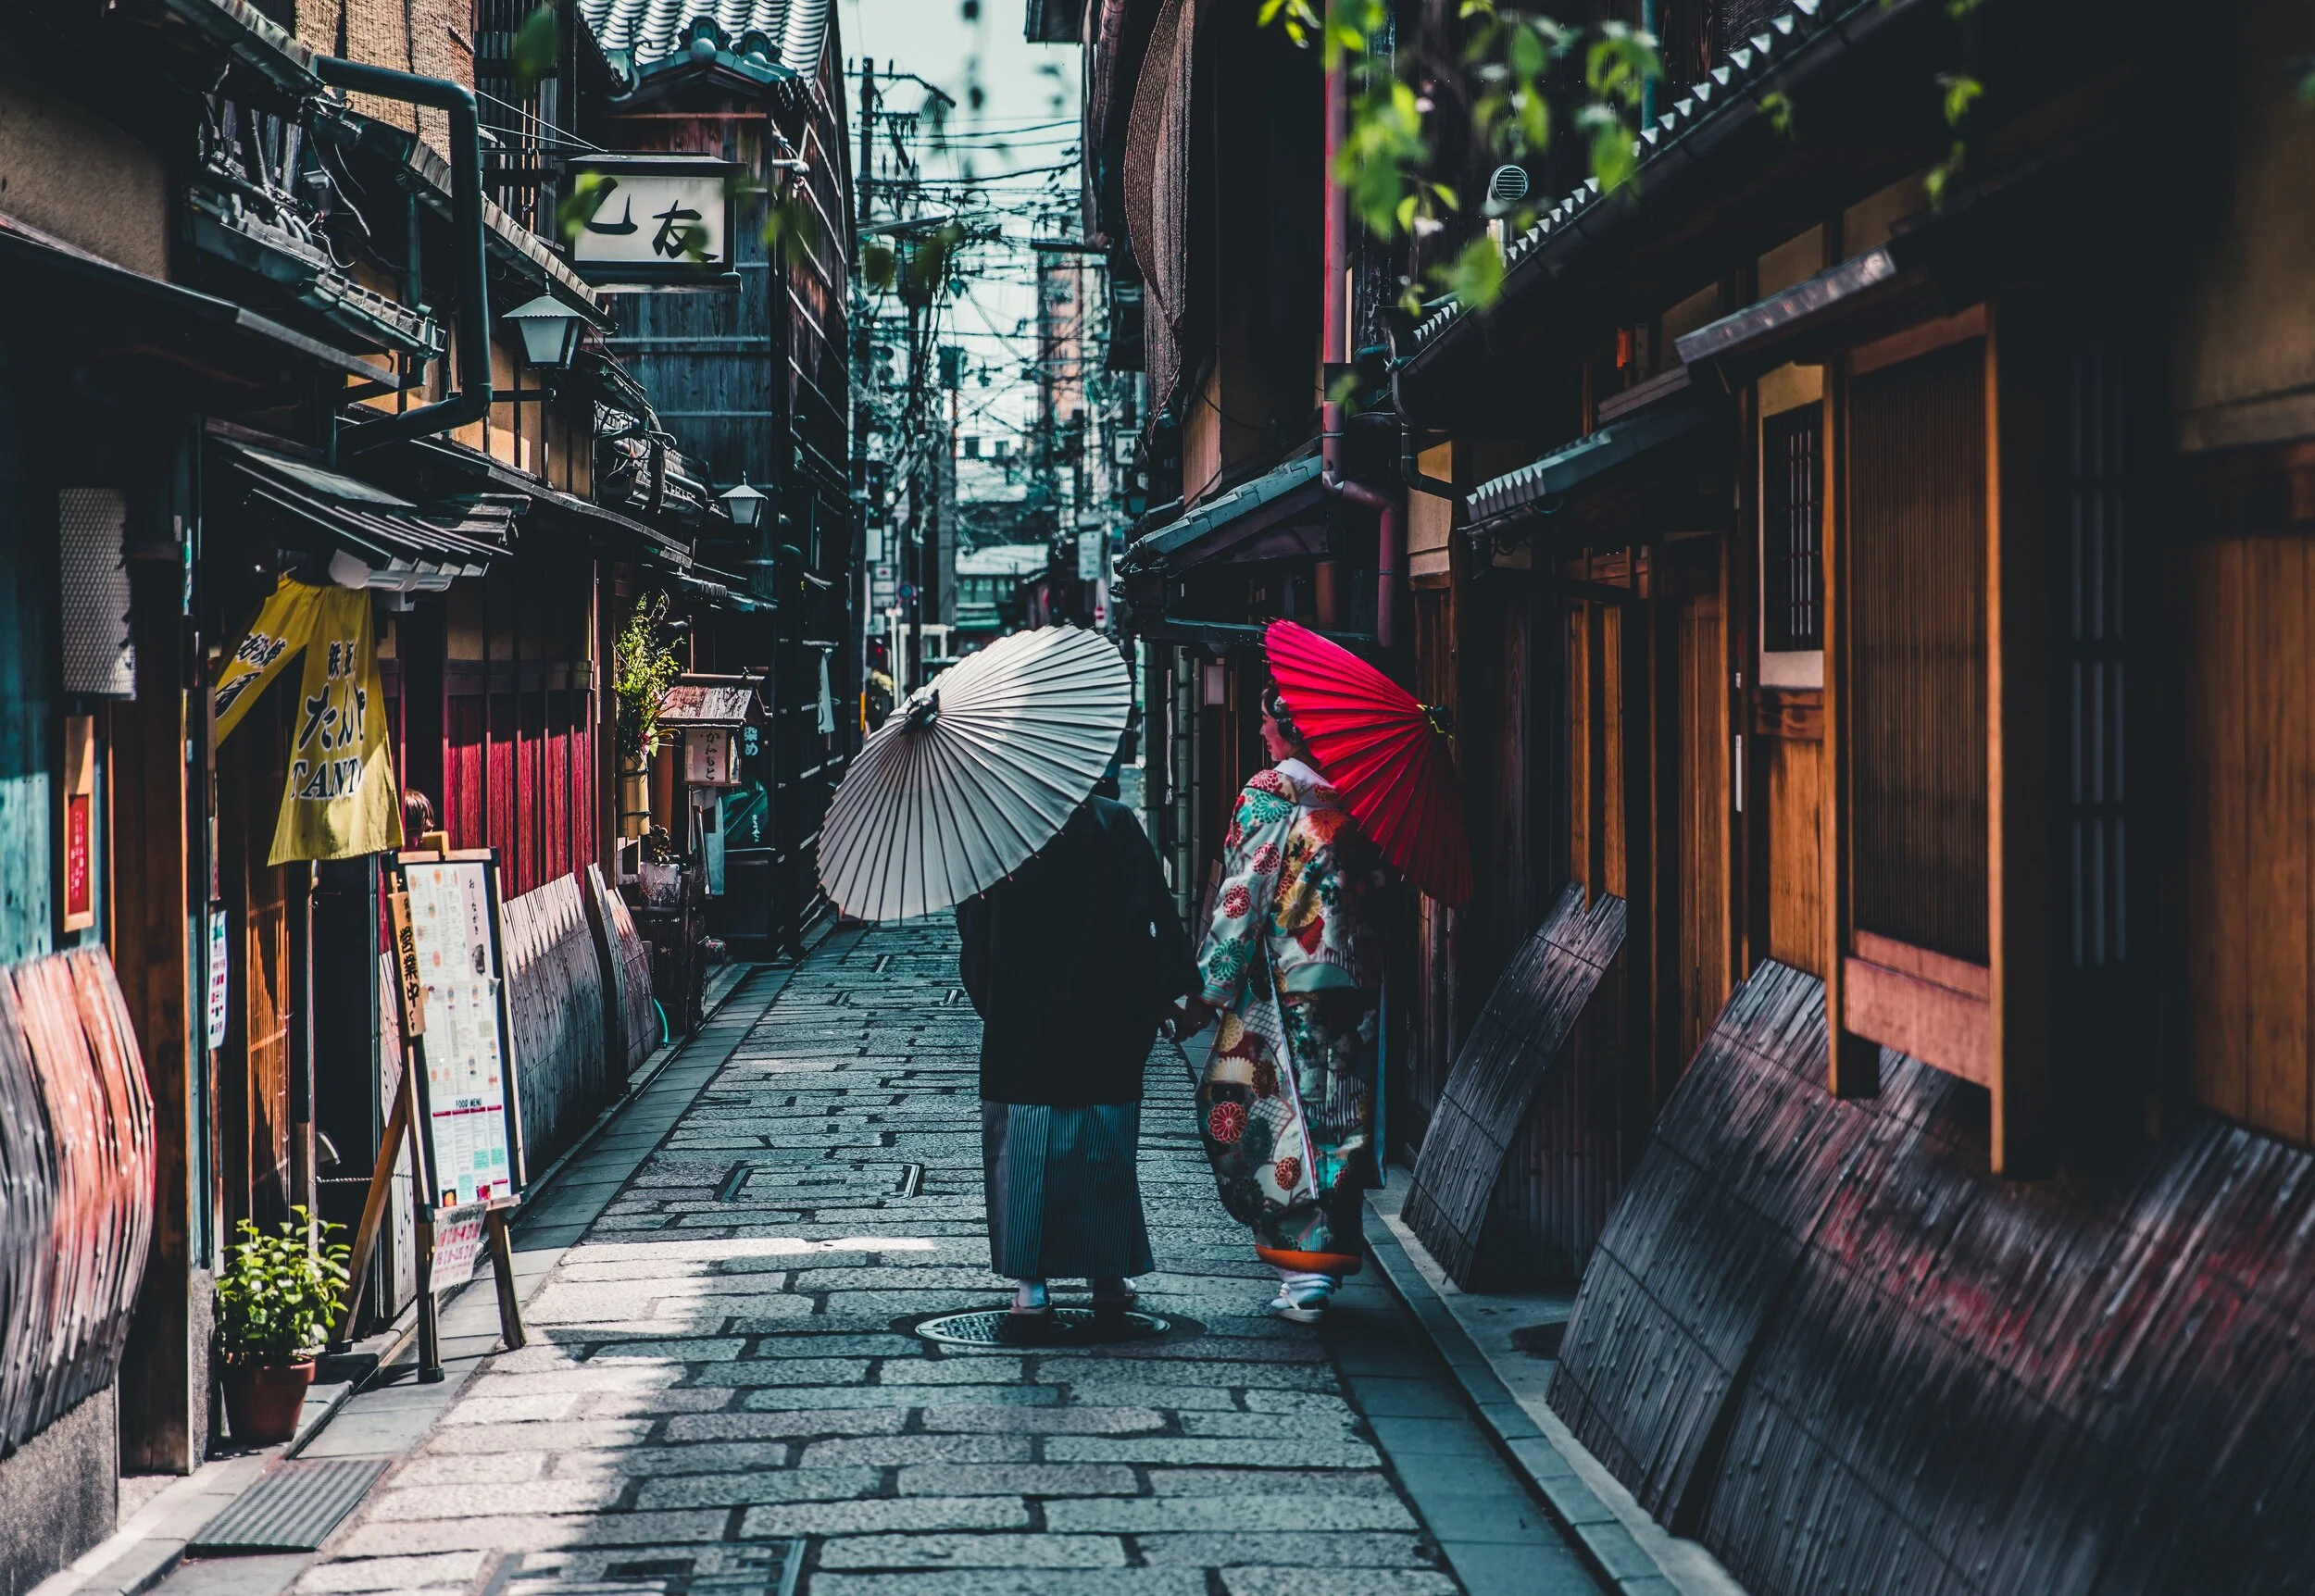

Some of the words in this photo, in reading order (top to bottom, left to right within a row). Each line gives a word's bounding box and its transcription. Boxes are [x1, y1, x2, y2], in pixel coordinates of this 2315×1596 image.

[291, 758, 362, 798] TANT
[456, 1099, 469, 1109] FOOD
[469, 1097, 482, 1107] MENU
